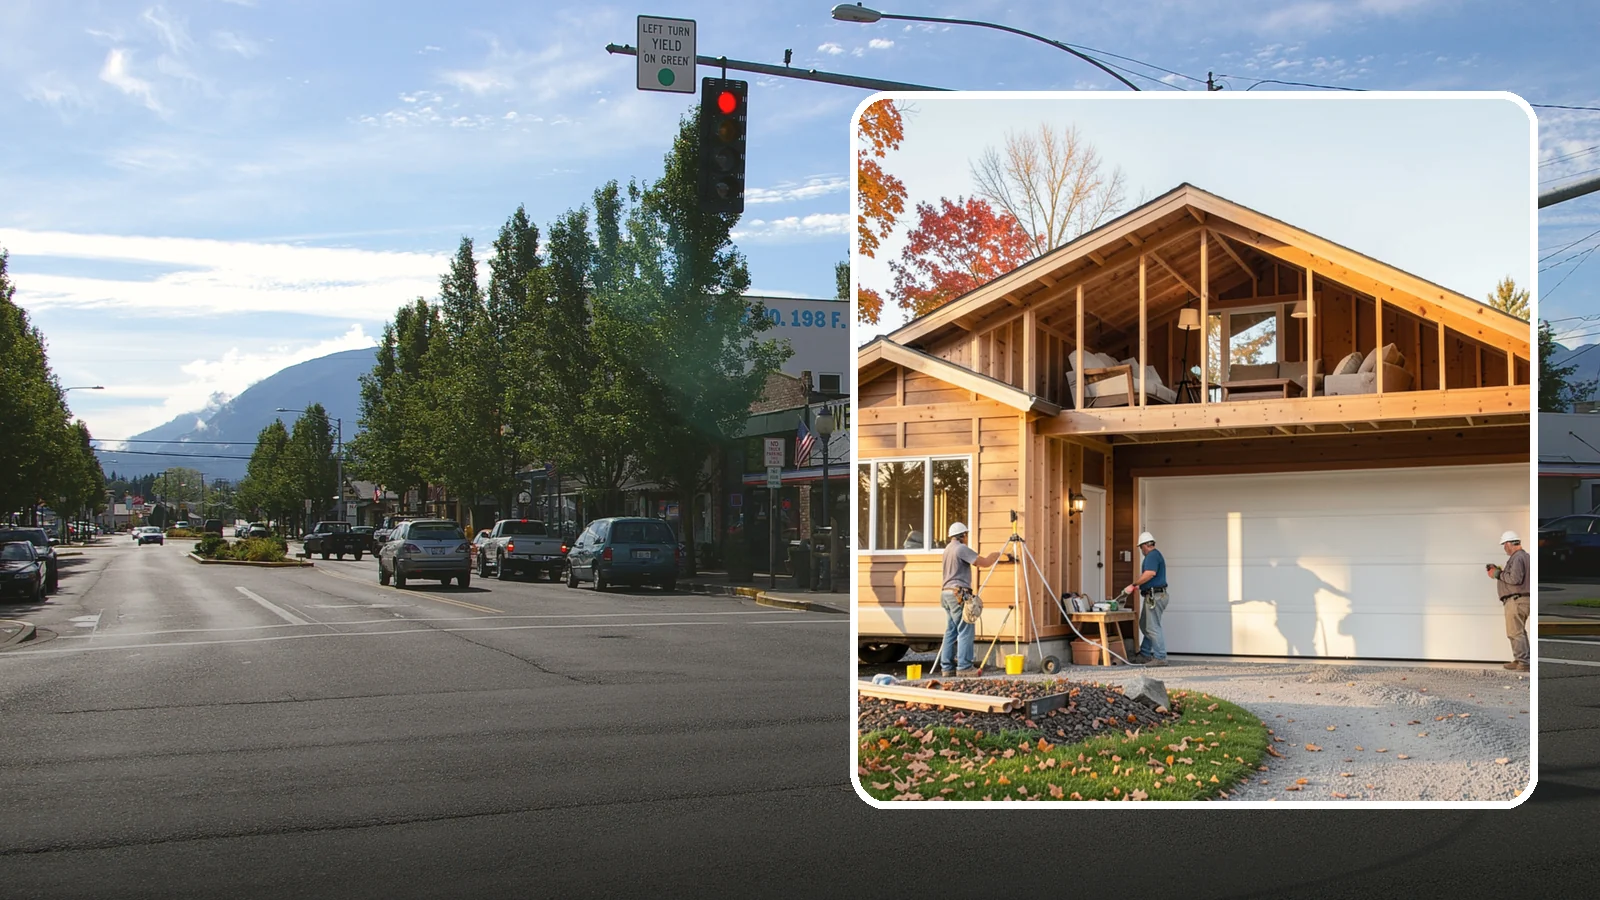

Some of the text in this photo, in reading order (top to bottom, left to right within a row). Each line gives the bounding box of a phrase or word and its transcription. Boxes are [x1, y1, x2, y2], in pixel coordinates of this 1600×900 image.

[643, 23, 690, 37] LEFT TURN
[652, 38, 682, 52] YIELD
[644, 53, 689, 66] ON GREEN
[791, 309, 826, 328] 198
[831, 311, 847, 329] F.
